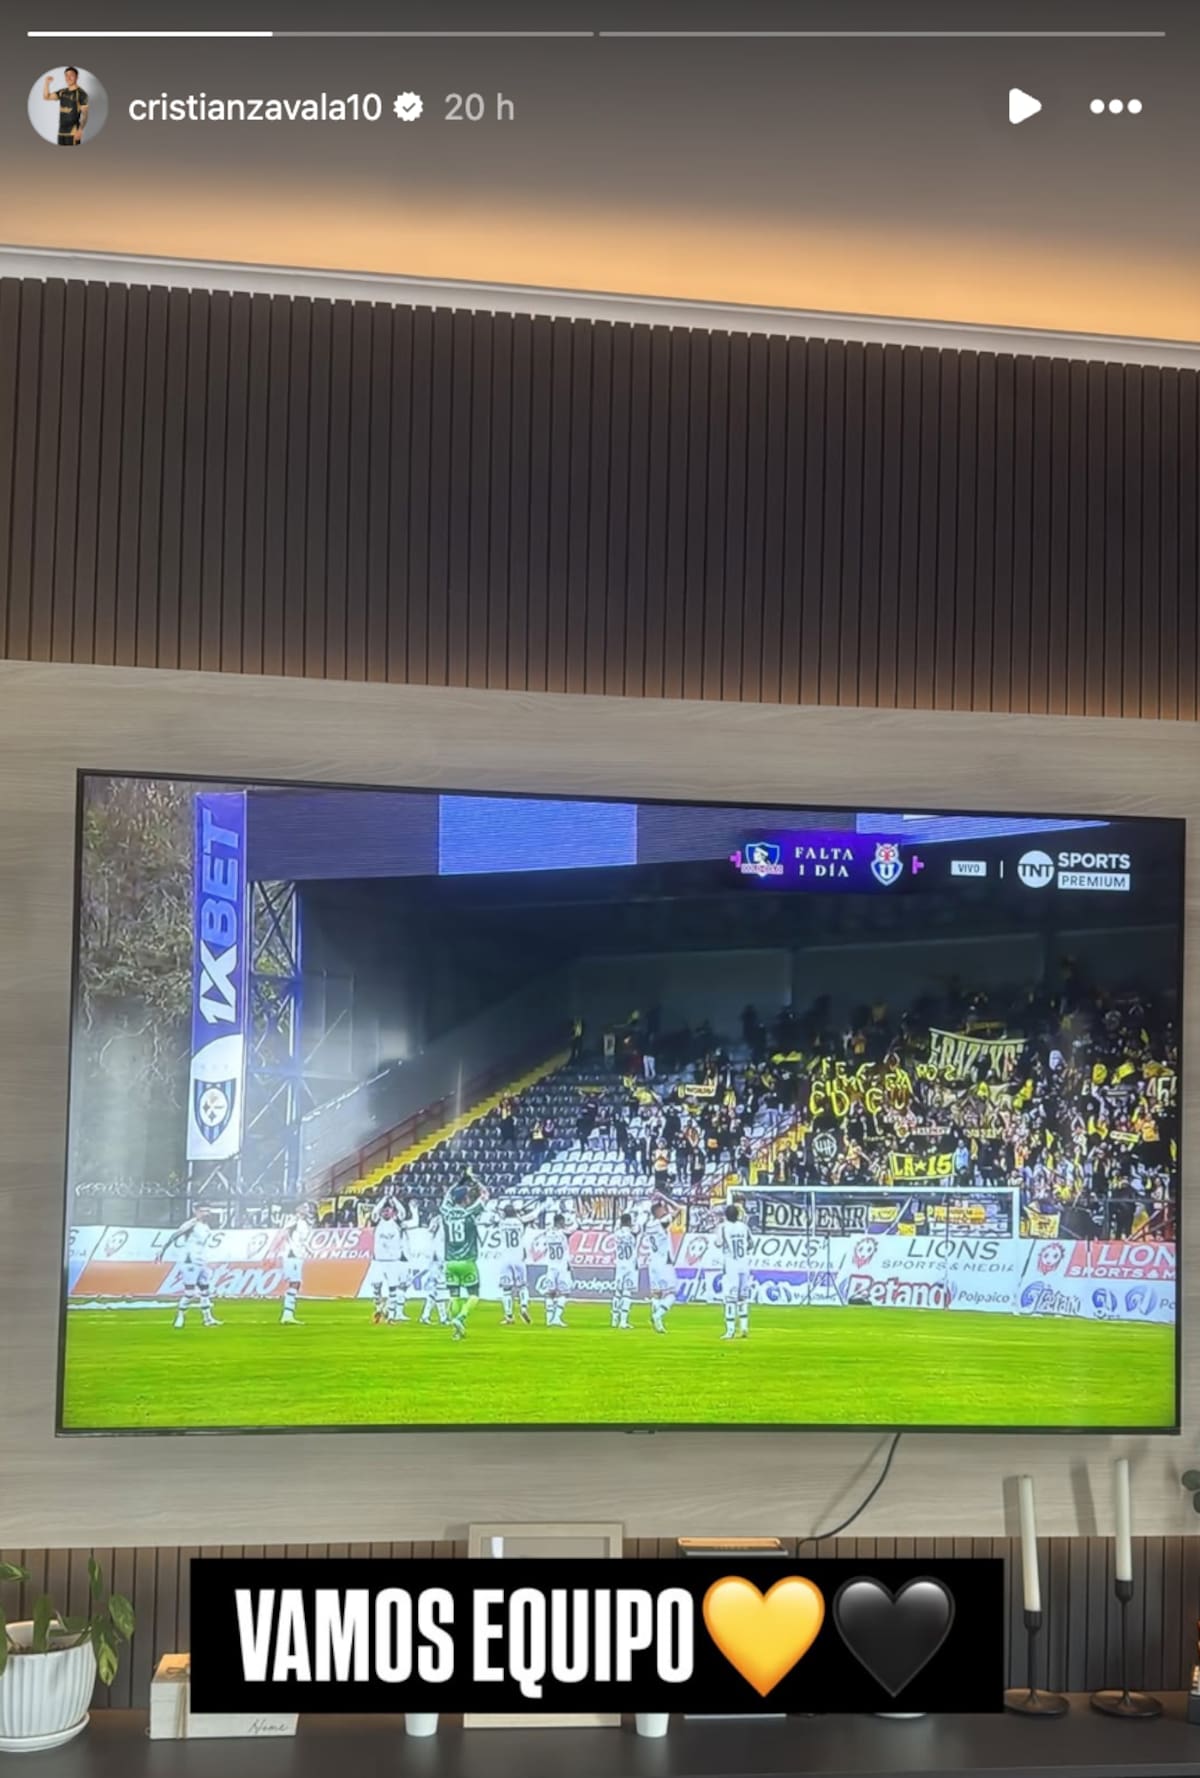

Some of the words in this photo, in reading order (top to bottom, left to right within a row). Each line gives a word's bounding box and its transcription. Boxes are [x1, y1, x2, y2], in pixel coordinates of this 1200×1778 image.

[794, 847, 854, 861] FALTA
[1058, 852, 1131, 869] SPORTS
[815, 863, 849, 878] DÍA
[957, 863, 980, 873] VIVO
[1018, 863, 1055, 878] TNT
[1062, 875, 1126, 888] PREMIUM
[907, 1239, 1000, 1260] LIONS
[958, 1291, 1010, 1304] Polpaico
